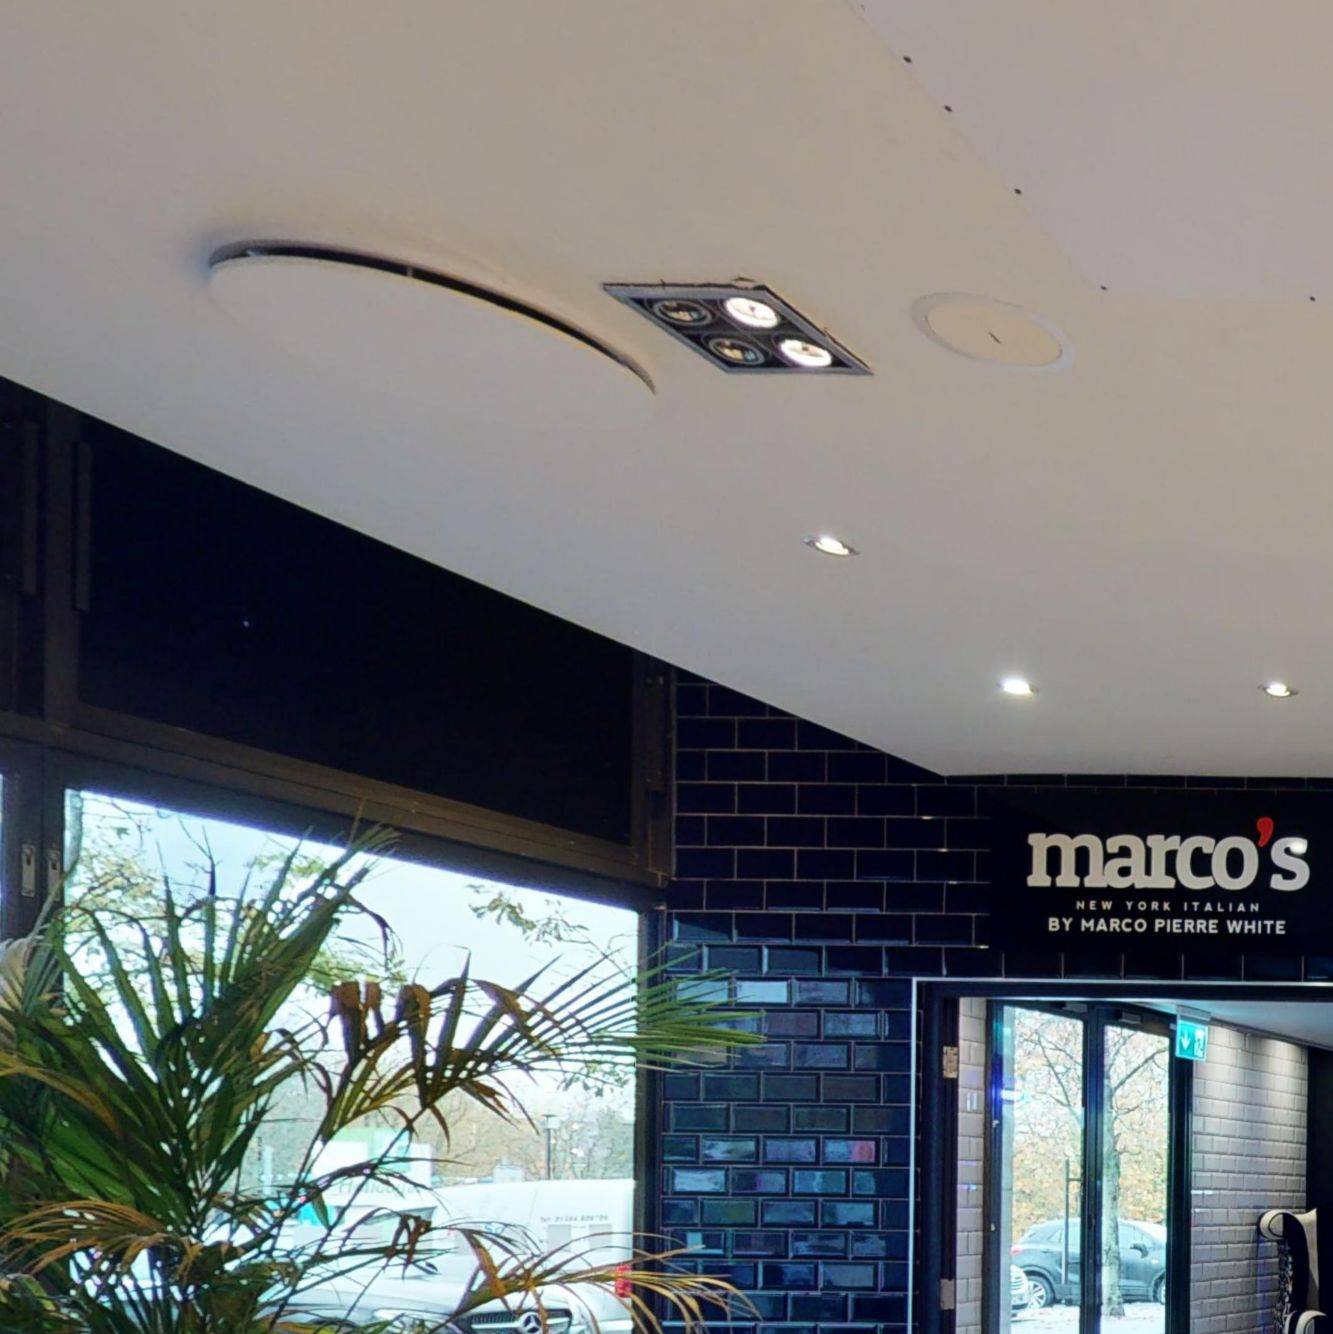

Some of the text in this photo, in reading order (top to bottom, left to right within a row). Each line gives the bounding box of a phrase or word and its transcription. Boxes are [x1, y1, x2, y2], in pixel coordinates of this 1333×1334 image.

[1027, 816, 1311, 892] marco's
[1075, 900, 1260, 913] NEW YORK ITALIAN
[1048, 917, 1287, 935] BY MARCO PIERRE WHITE
